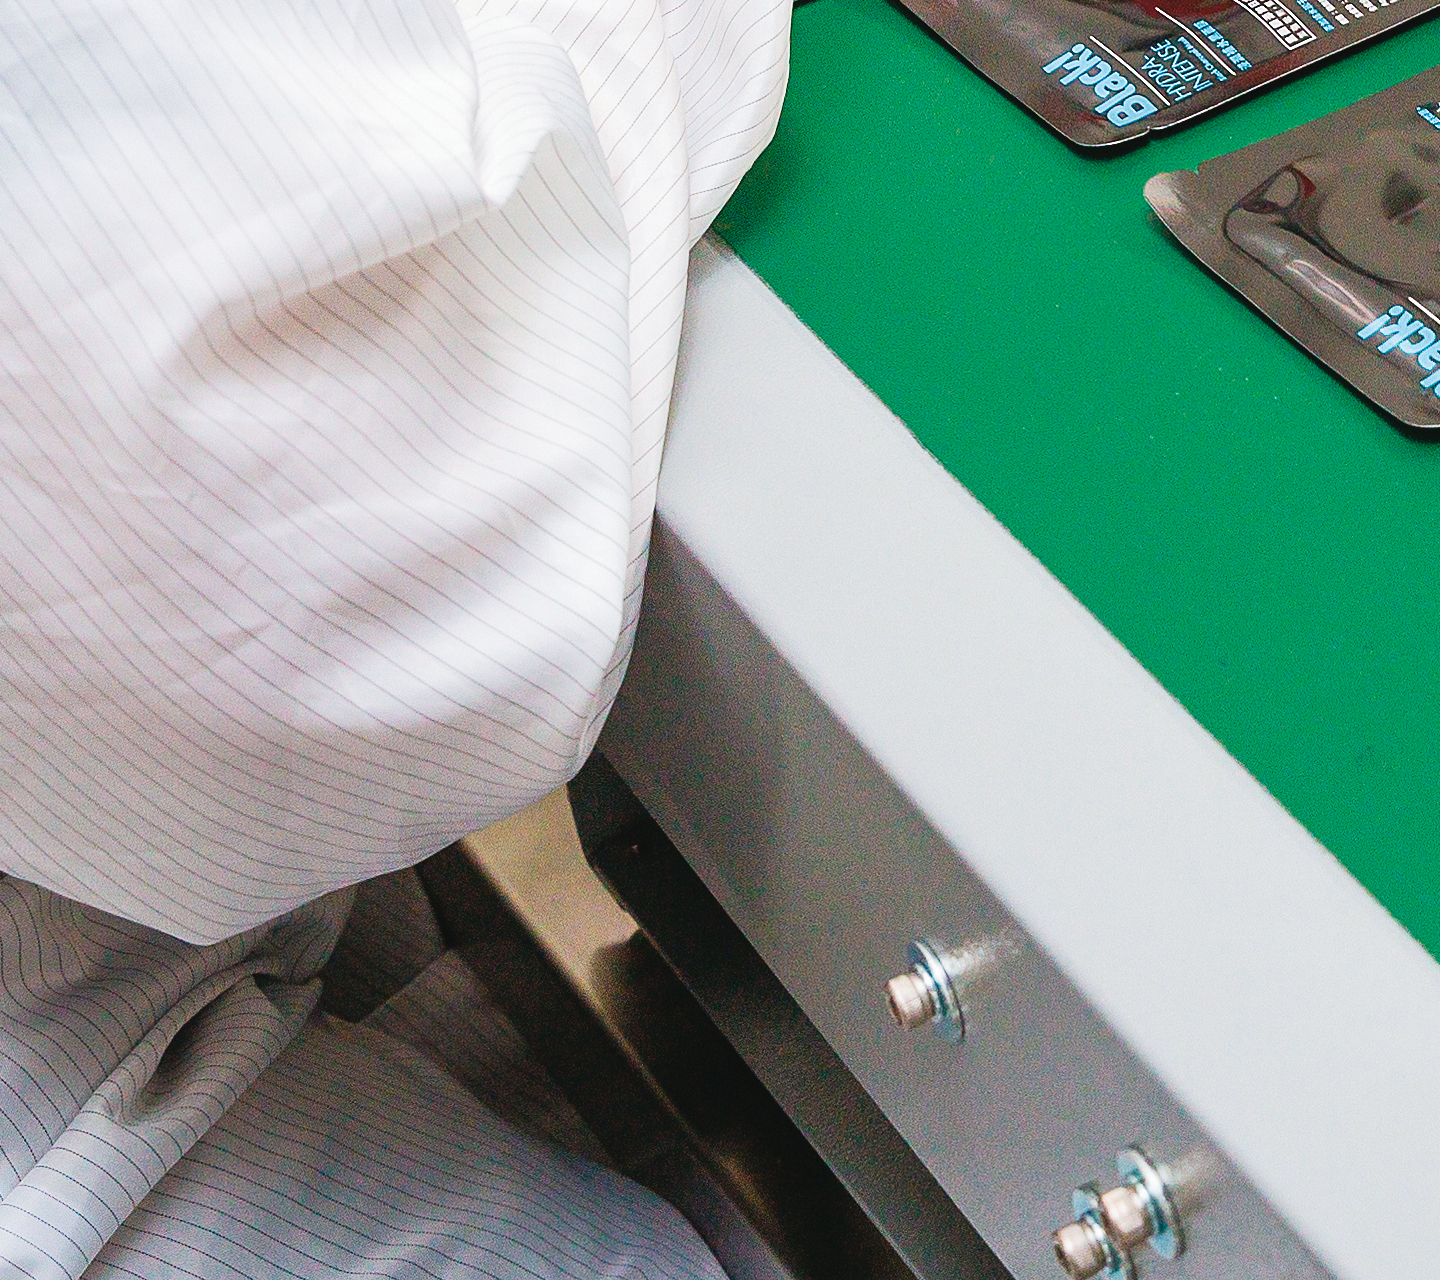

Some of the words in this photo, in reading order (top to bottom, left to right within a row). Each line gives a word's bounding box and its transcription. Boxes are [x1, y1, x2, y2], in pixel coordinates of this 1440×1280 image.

[1041, 43, 1159, 129] Black!
[1140, 56, 1190, 102] HYDRA-
[1149, 41, 1214, 92] INTENSE
